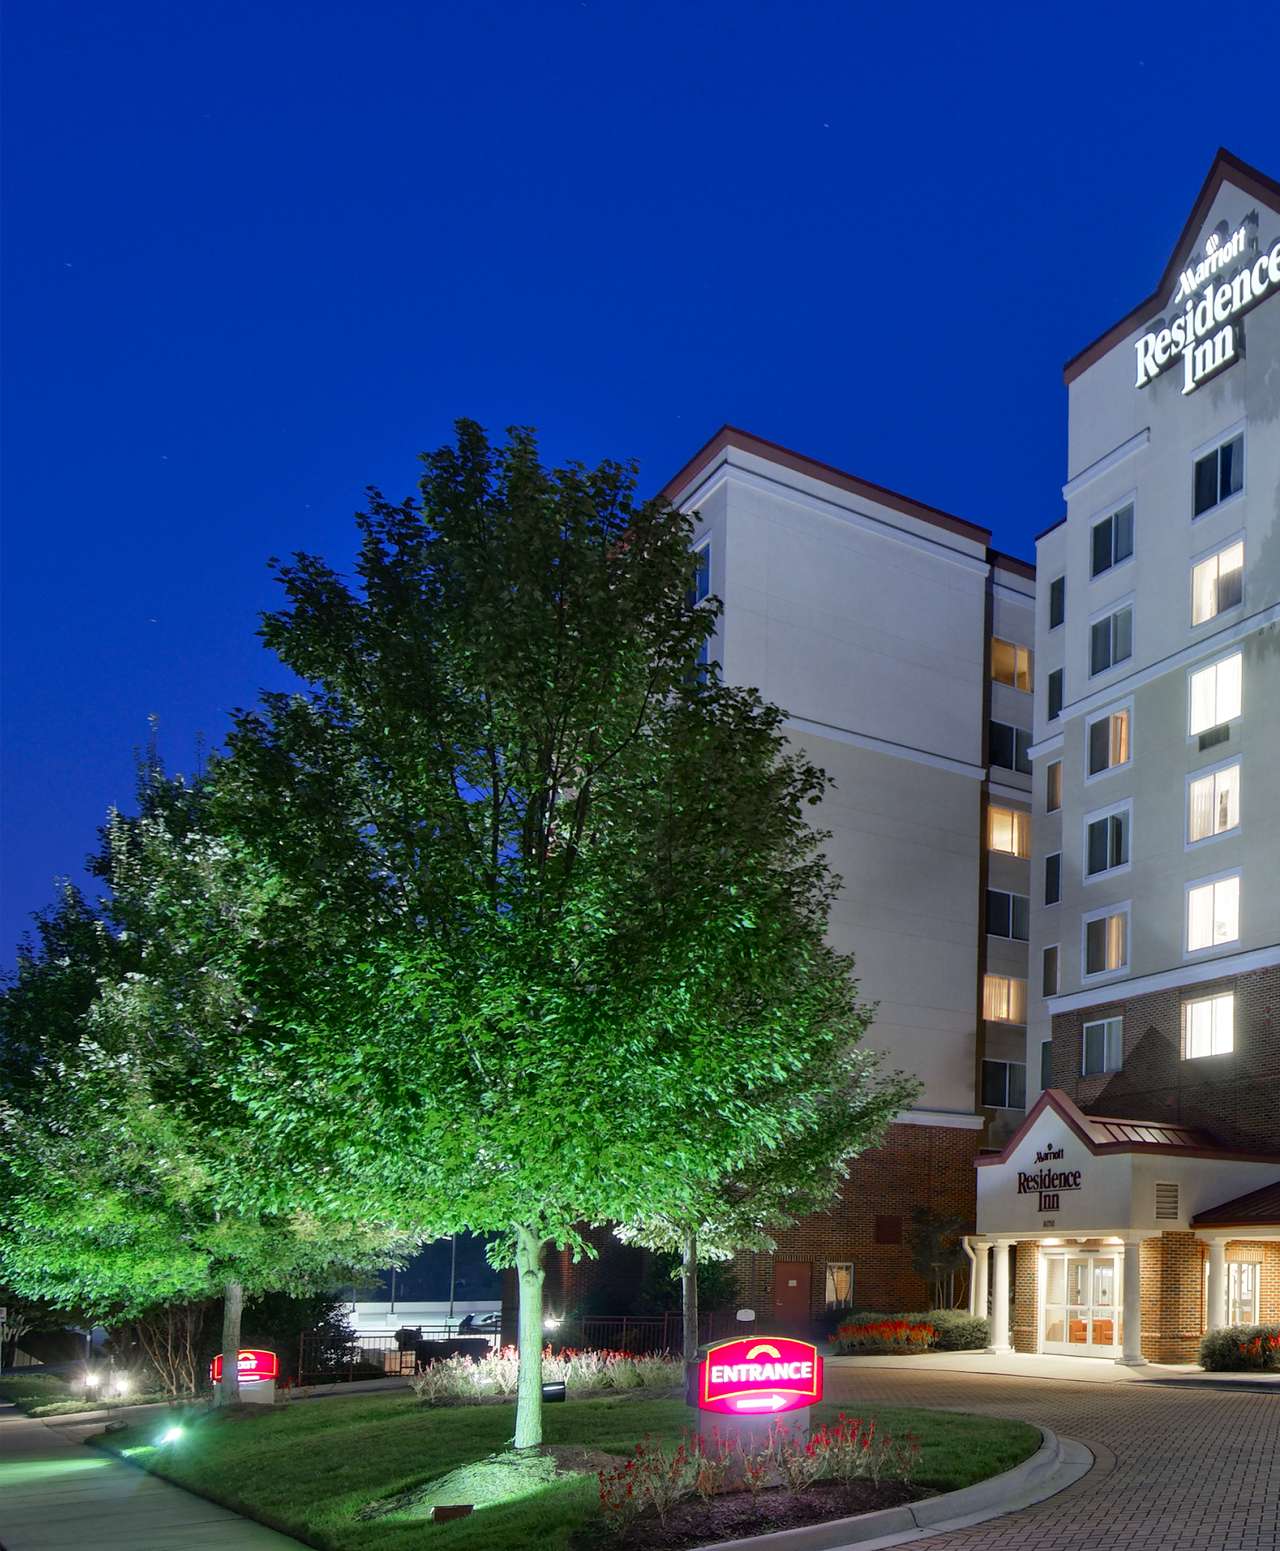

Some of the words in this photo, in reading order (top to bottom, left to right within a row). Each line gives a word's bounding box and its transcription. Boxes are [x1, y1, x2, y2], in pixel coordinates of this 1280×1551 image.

[1174, 226, 1247, 304] Marriott
[1181, 324, 1236, 395] Inn
[1017, 1168, 1082, 1194] Residence
[1037, 1191, 1060, 1212] Inn
[711, 1361, 813, 1383] ENTRANCE
